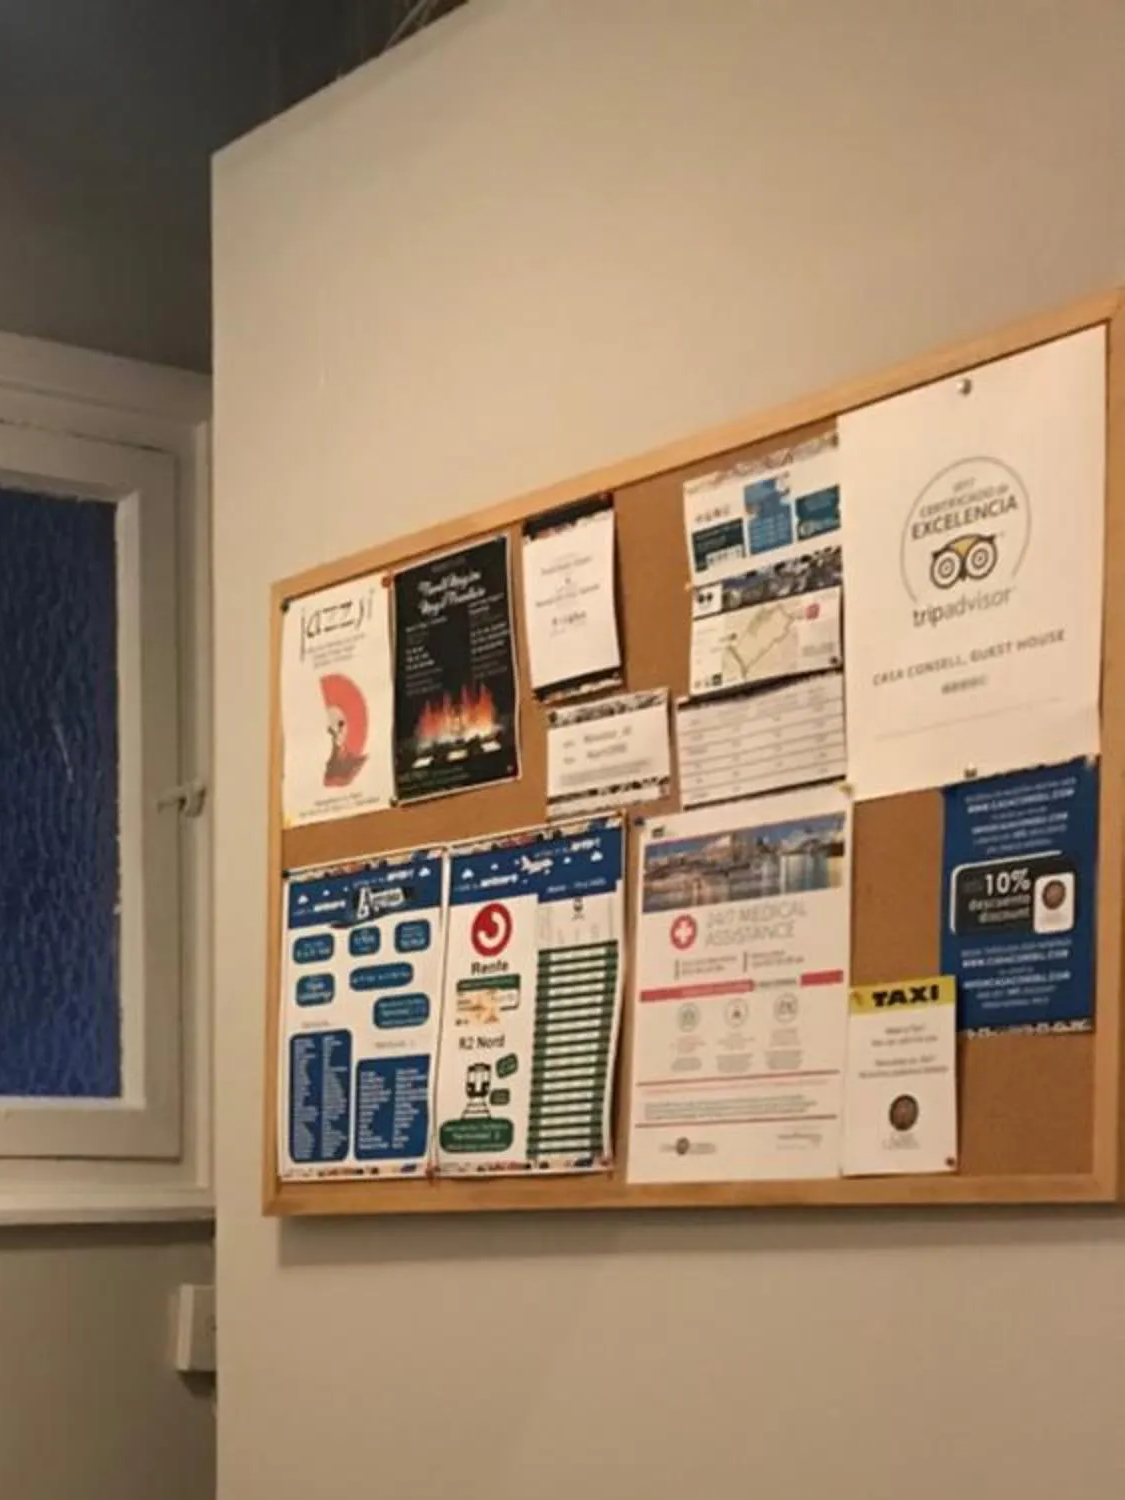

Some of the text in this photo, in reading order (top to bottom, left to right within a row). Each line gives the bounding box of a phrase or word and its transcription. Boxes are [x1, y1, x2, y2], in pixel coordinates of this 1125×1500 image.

[911, 494, 1019, 540] EXCELENCIA
[912, 588, 1012, 628] tripadvisor
[873, 668, 904, 686] CASA
[970, 641, 1012, 663] GUEST
[1016, 629, 1065, 651] HOUSE
[984, 868, 1031, 895] 10%
[872, 984, 940, 1008] TAXI
